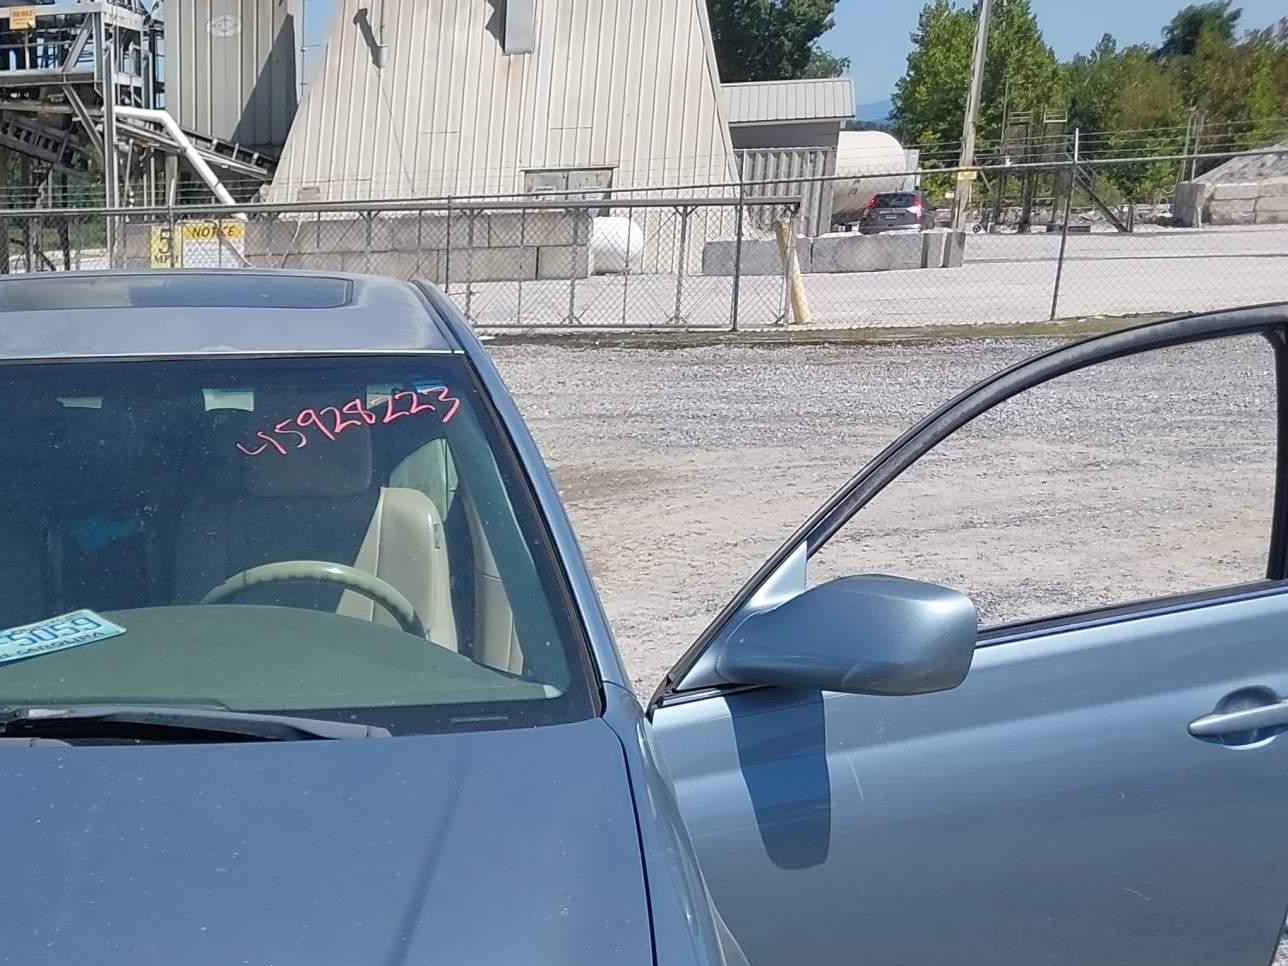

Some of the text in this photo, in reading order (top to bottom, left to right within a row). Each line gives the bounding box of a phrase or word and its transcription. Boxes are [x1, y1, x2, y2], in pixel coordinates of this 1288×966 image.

[159, 228, 173, 254] 5
[192, 225, 235, 237] NOTCE
[236, 386, 461, 456] 45928223
